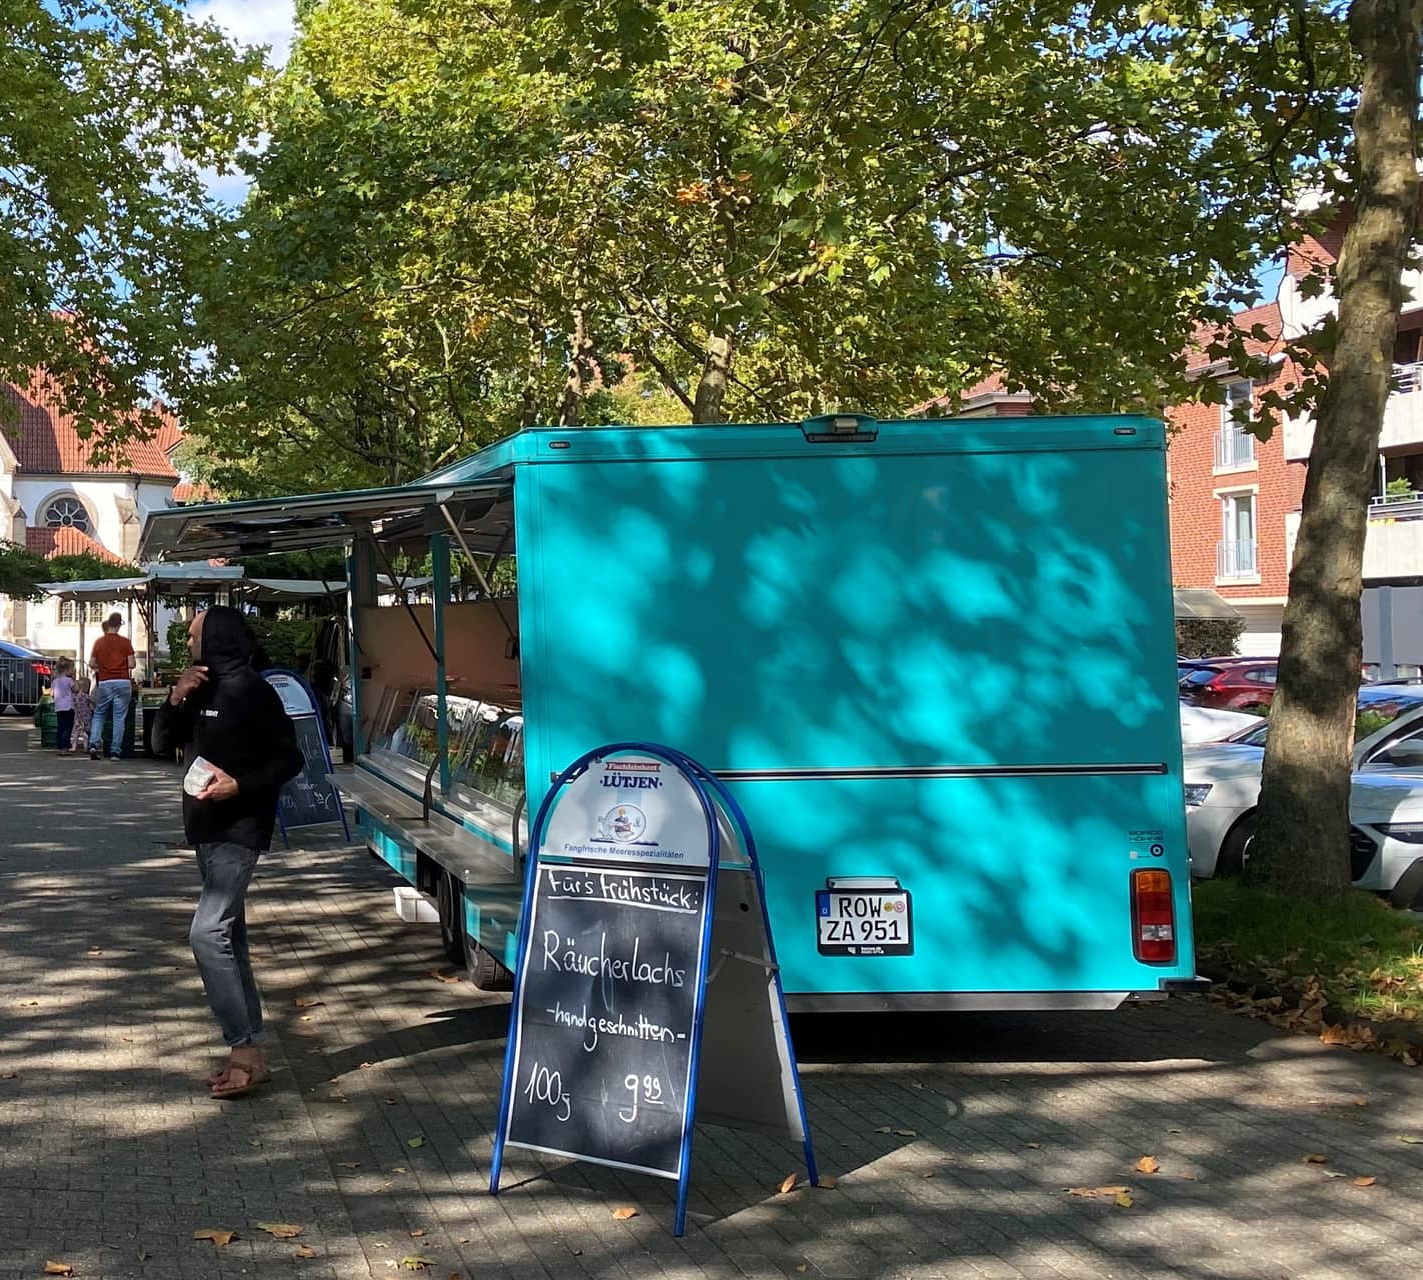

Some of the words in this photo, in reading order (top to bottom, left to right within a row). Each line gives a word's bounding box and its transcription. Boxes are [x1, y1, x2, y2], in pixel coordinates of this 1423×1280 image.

[563, 843, 608, 854] Fangfrische
[609, 846, 684, 859] Meeresspezialitäten
[838, 897, 882, 918] ROW
[826, 920, 855, 941] ZA
[860, 920, 901, 941] 951
[543, 929, 685, 988] Räucherlachs
[524, 1061, 571, 1122] 100g
